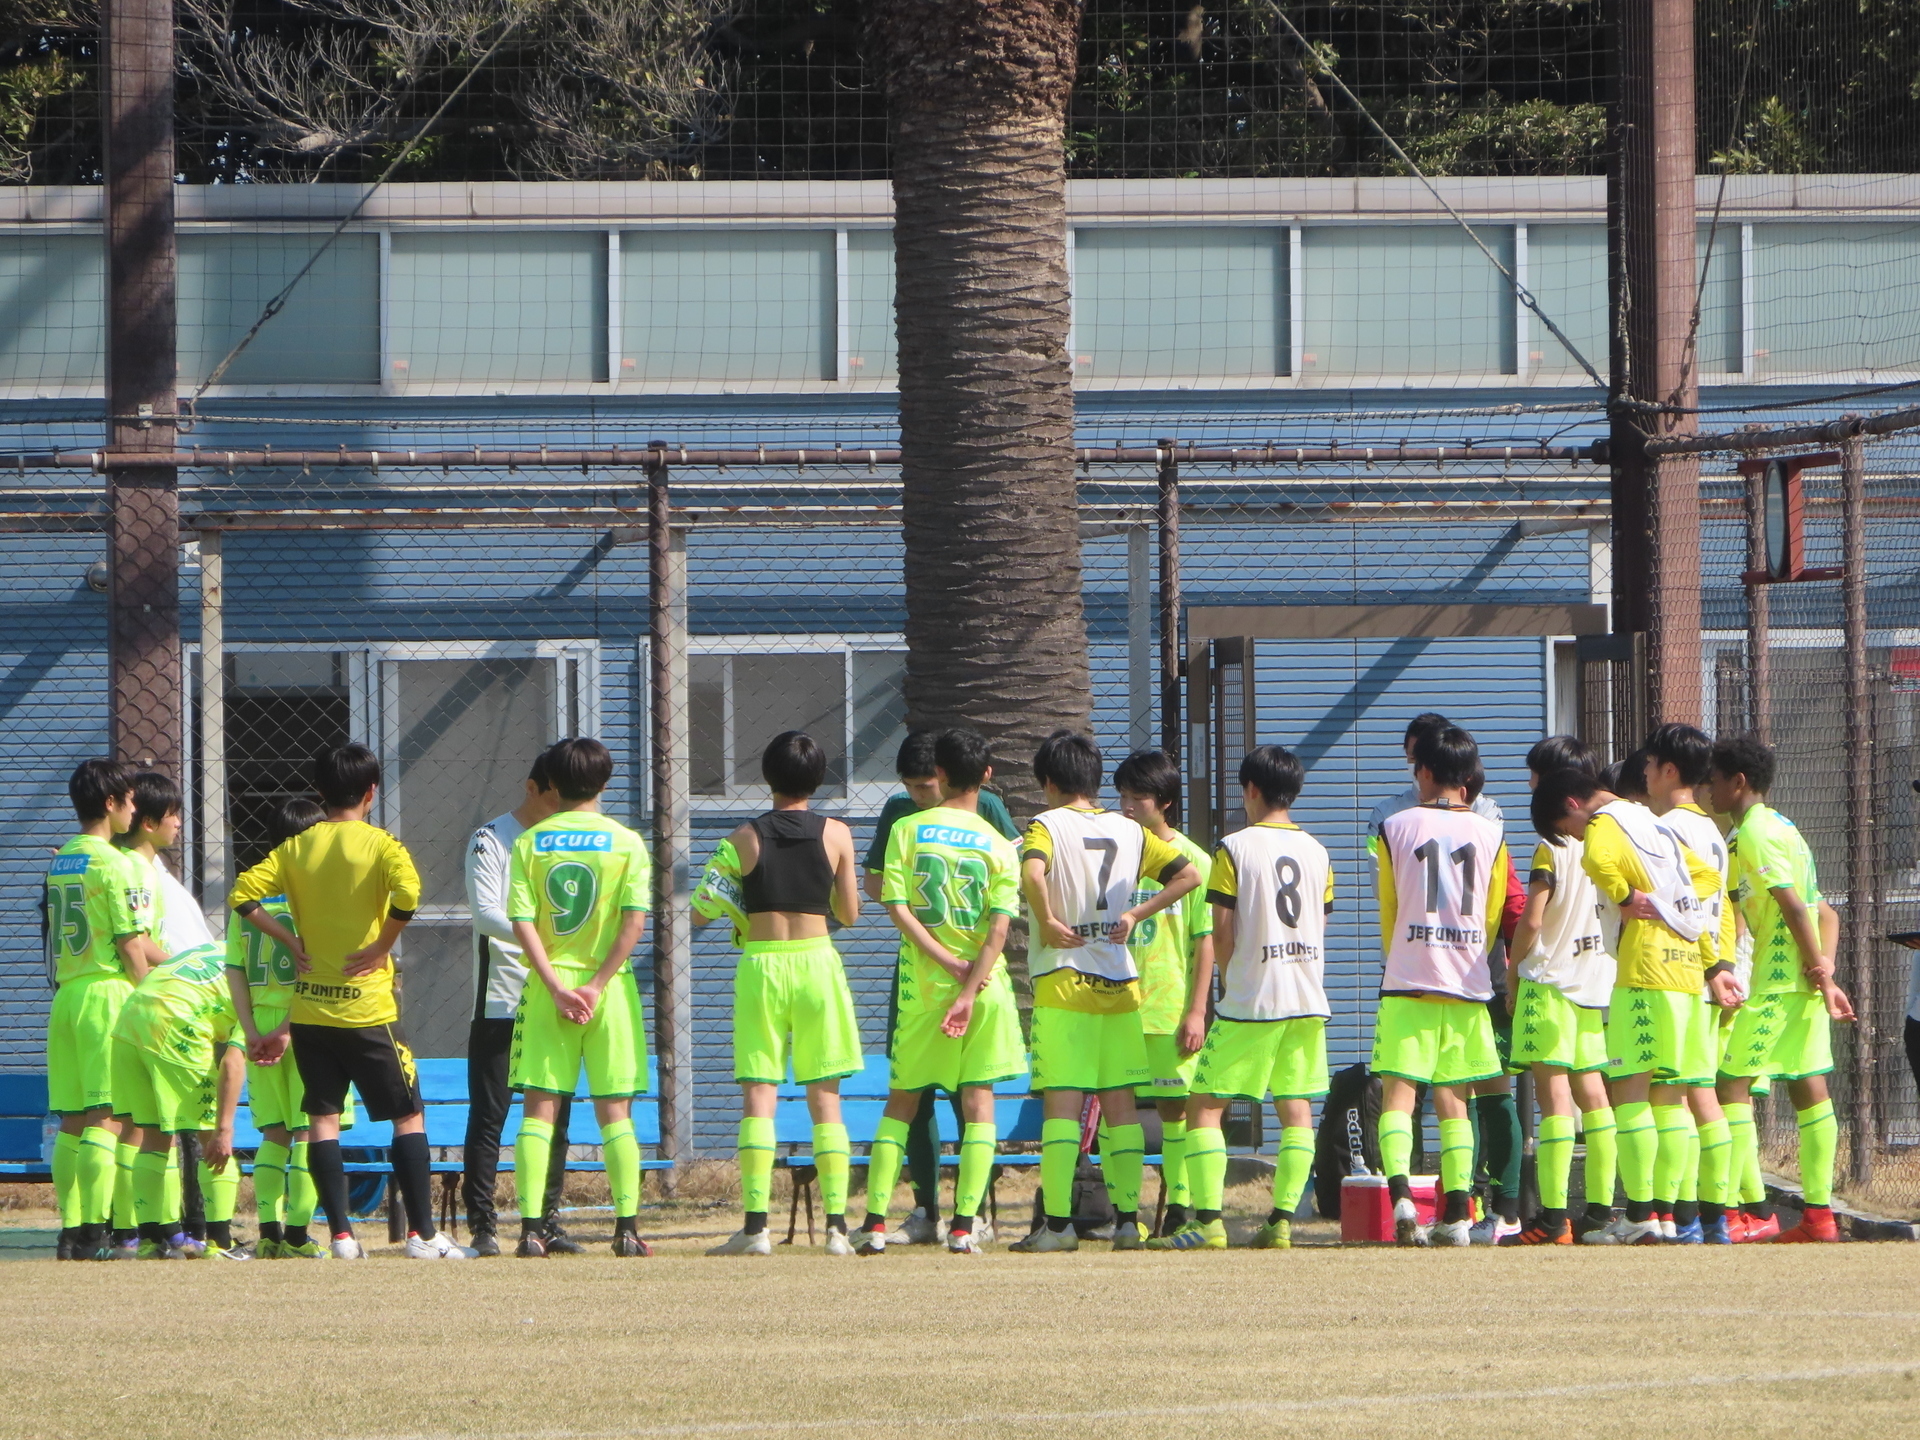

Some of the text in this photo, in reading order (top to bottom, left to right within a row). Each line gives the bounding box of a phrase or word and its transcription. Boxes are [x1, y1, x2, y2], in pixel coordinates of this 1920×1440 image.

[540, 834, 607, 848] acure
[923, 827, 987, 847] acure
[1082, 836, 1119, 911] 7
[1413, 837, 1477, 916] 11
[545, 860, 597, 936] 9
[913, 851, 990, 931] 33
[1275, 855, 1301, 929] 8
[1406, 924, 1482, 944] JEF UNITE
[1573, 935, 1601, 957] JEF
[1662, 949, 1687, 963] JEF
[295, 981, 362, 1000] EF UNITED
